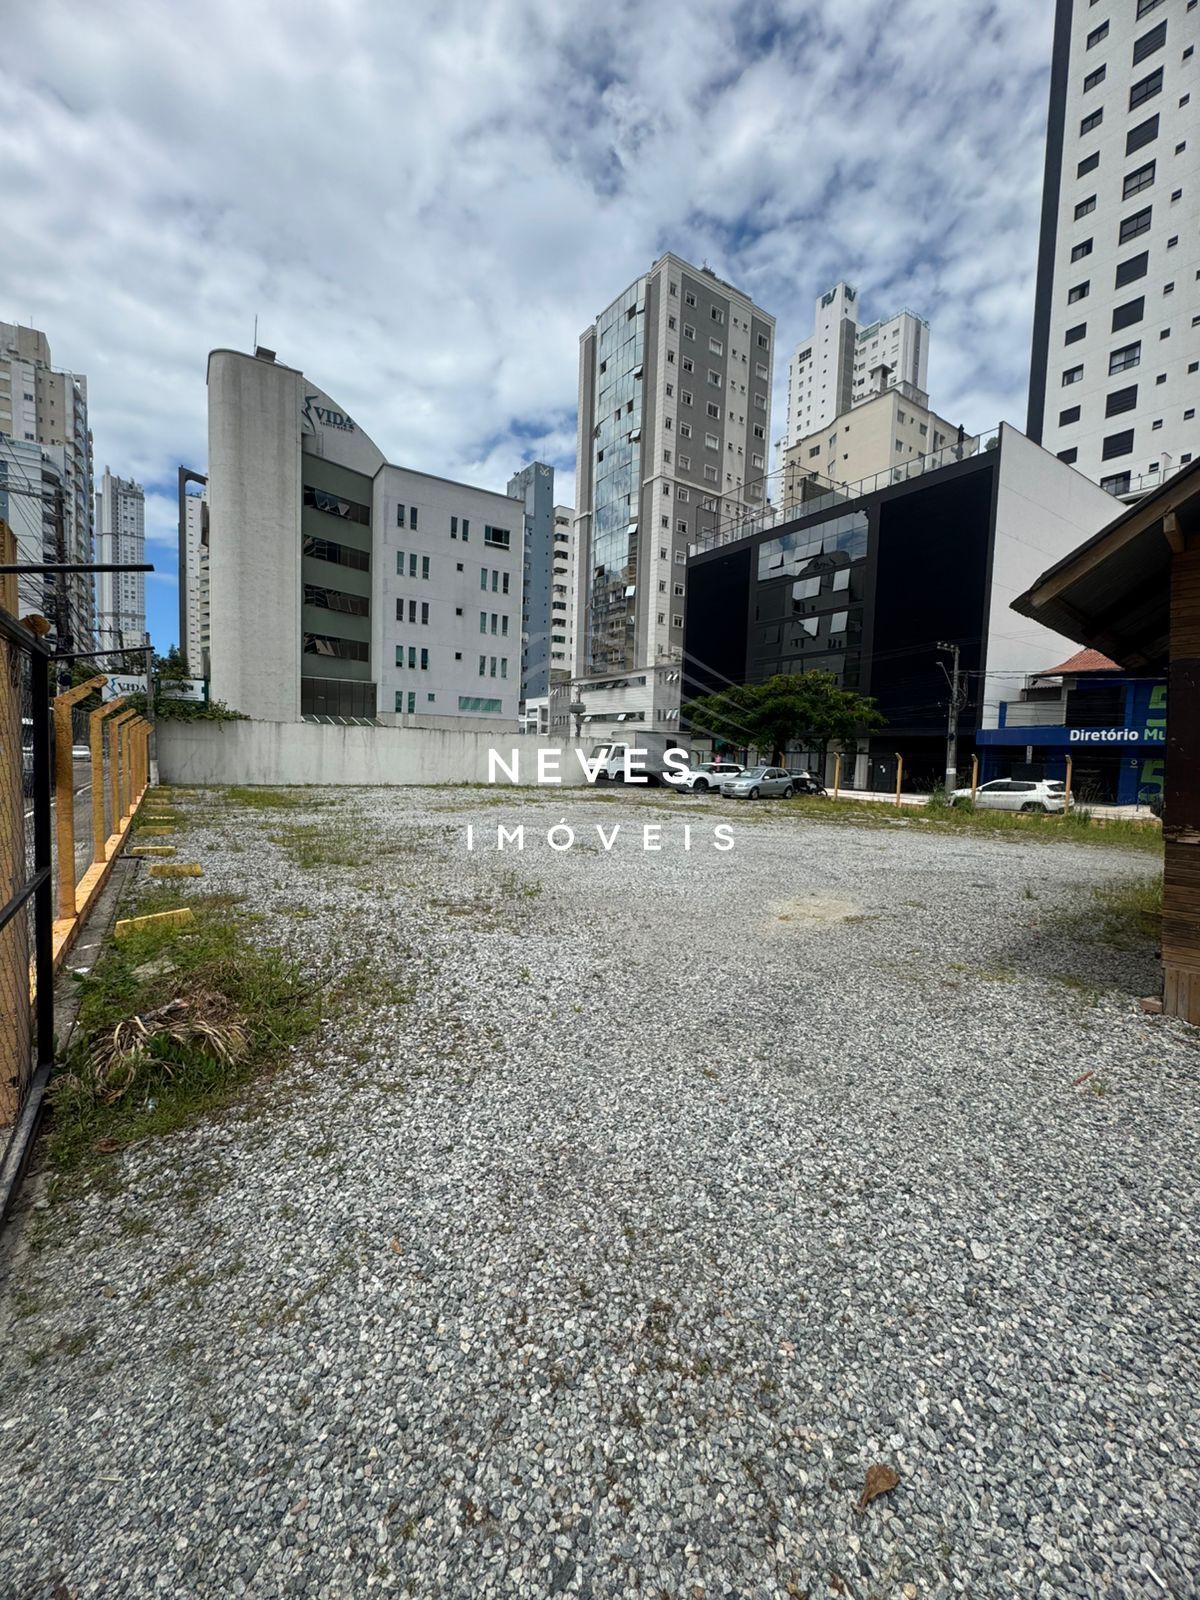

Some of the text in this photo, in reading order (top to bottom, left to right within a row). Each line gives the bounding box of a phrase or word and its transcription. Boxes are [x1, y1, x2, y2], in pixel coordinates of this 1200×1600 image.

[313, 406, 356, 430] VIDA
[118, 683, 148, 693] VIDA
[1069, 728, 1139, 741] Diretório
